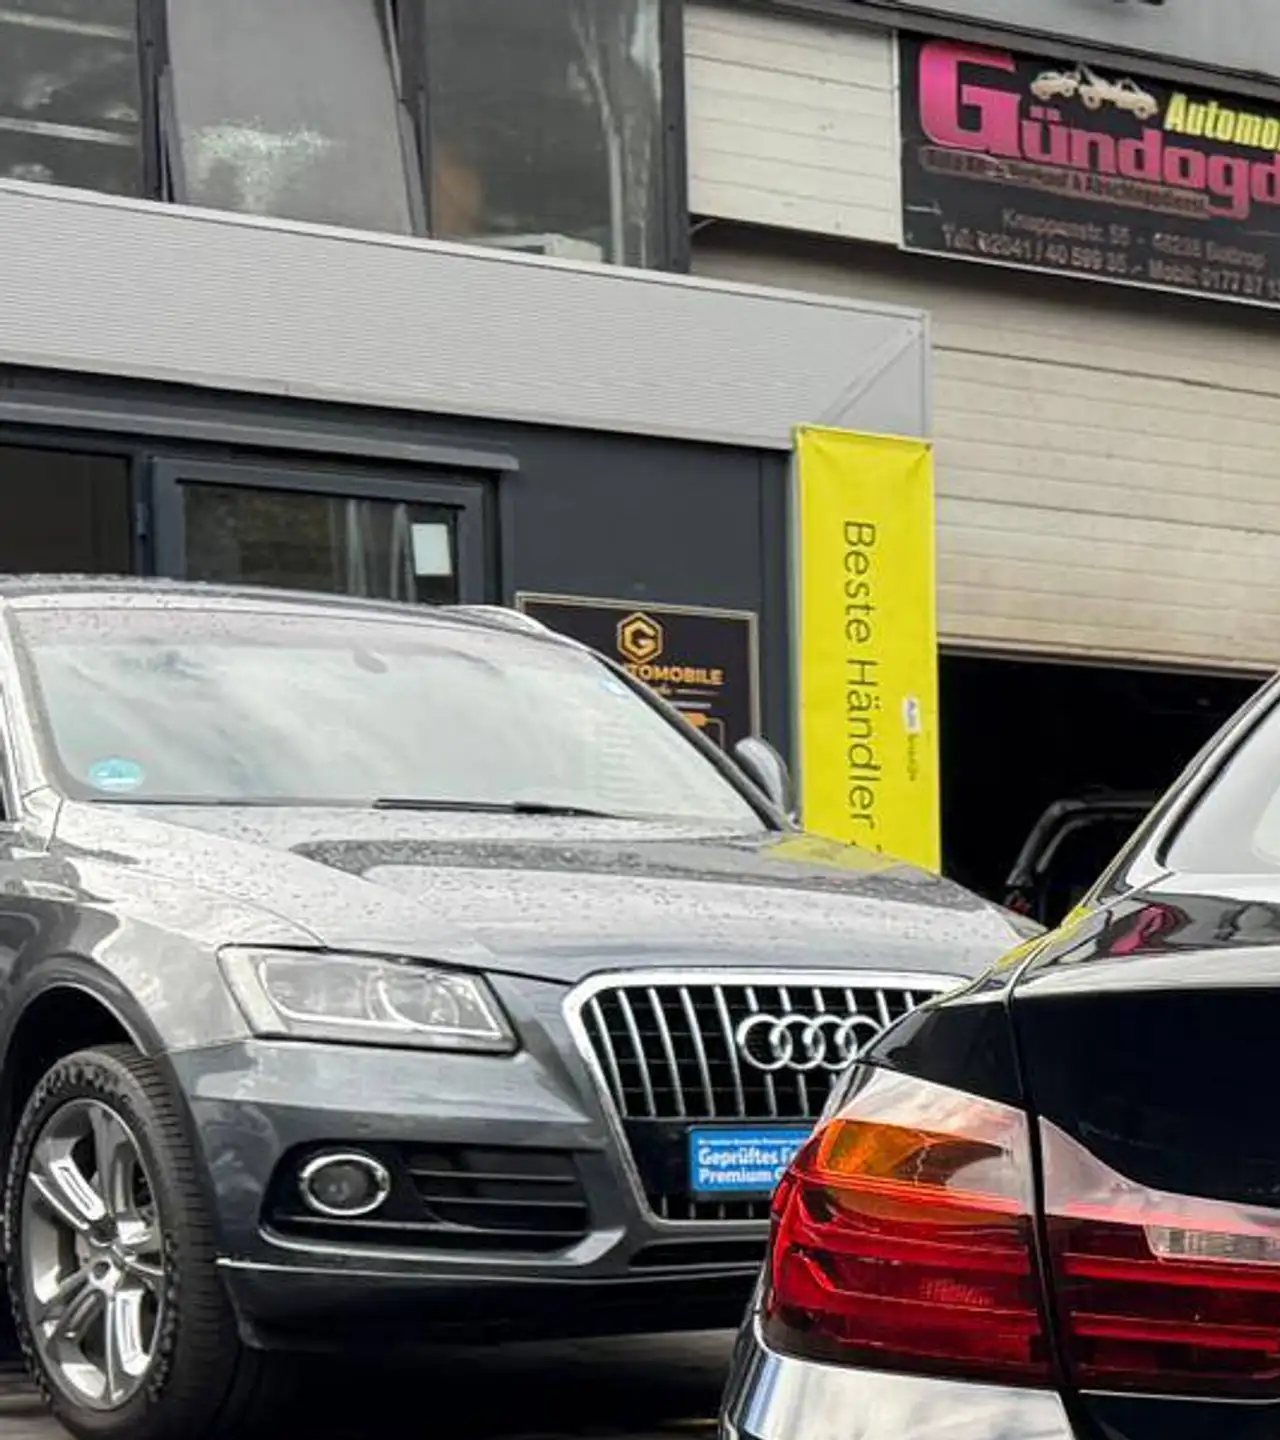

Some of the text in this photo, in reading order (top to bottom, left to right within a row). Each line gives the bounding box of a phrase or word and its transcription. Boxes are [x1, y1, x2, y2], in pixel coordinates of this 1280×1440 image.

[844, 520, 882, 831] Beste Händler
[698, 1146, 779, 1170] Geprüftes
[698, 1166, 773, 1184] Premium
